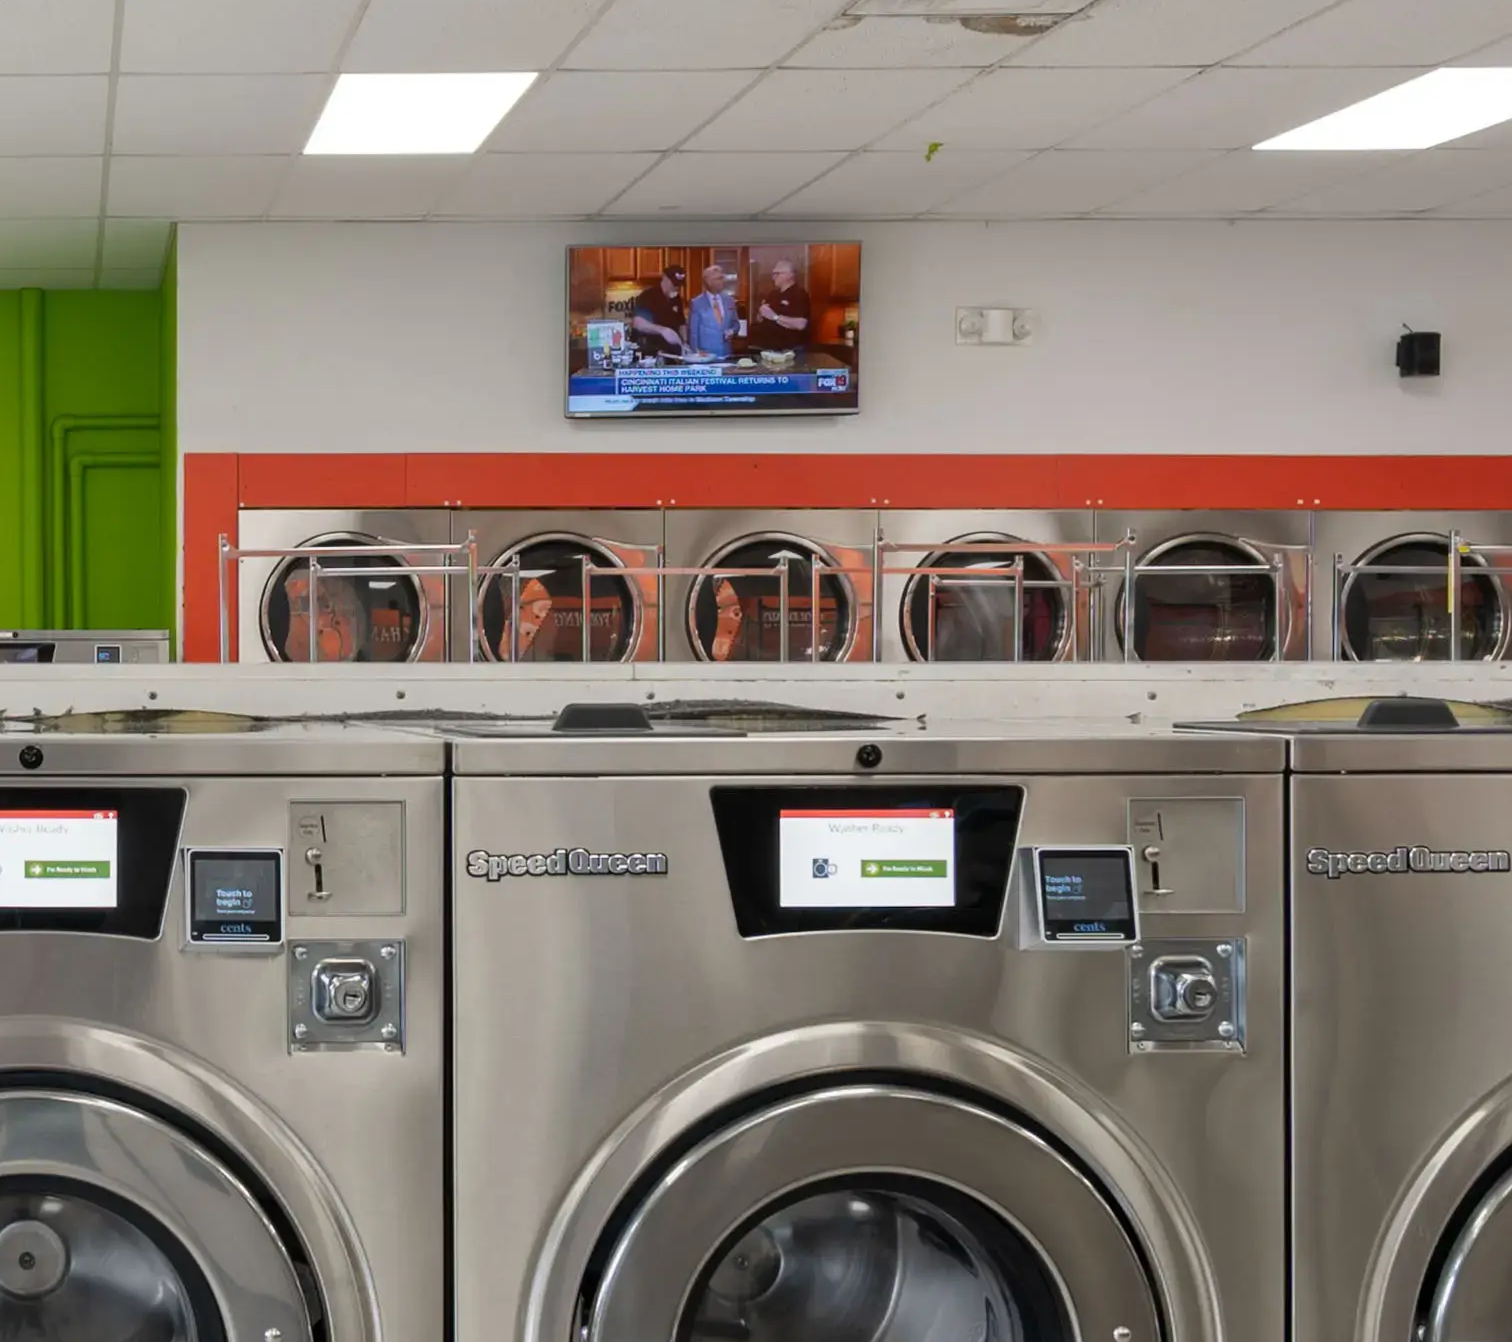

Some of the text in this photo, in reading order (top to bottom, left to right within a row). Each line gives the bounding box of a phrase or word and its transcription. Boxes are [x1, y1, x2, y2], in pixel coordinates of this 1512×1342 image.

[621, 377, 788, 386] CINCINNATI ITALIAN FESTIVAL RETURNS TO
[621, 385, 708, 393] HARVEST HOME PARK
[466, 847, 668, 882] Speed Queen
[1307, 846, 1511, 879] Speed Queen
[216, 889, 253, 898] Touch to
[216, 898, 241, 907] begin
[220, 923, 252, 933] cents
[1073, 922, 1106, 932] cents
